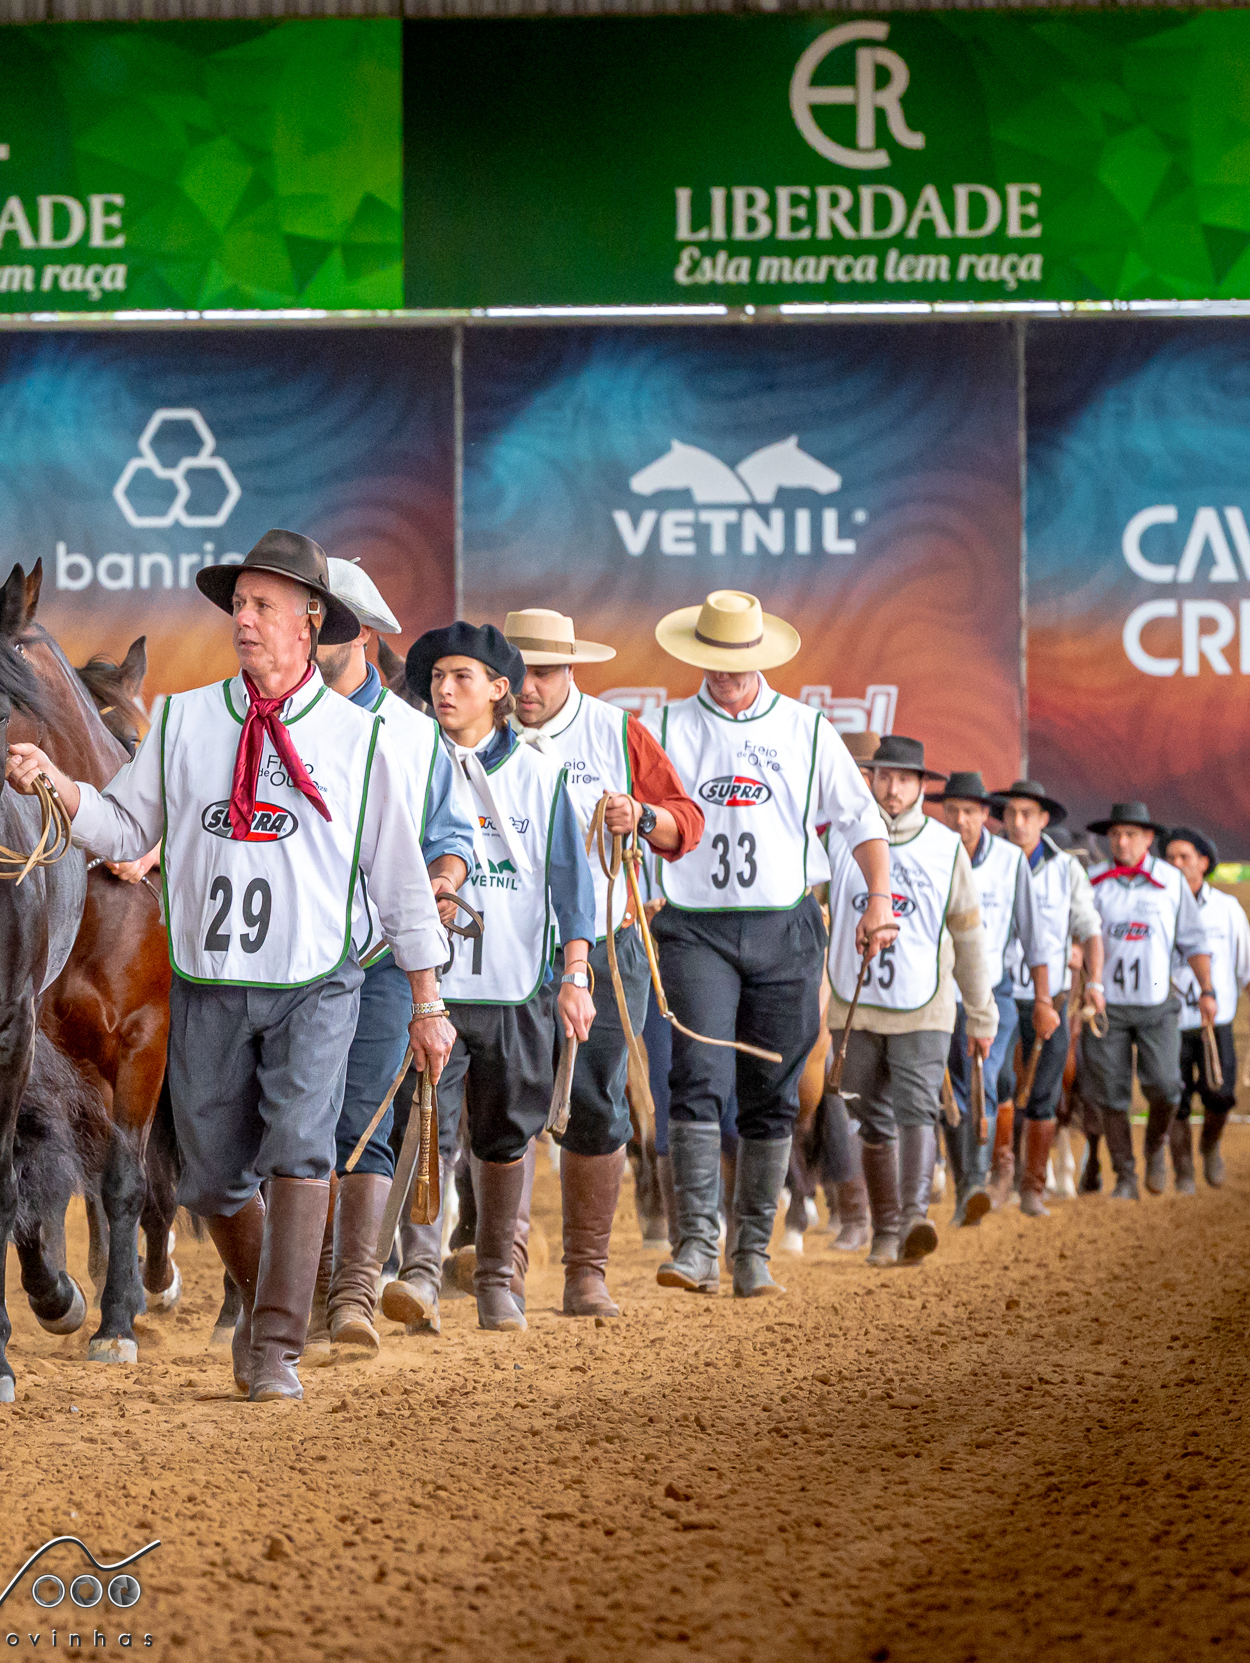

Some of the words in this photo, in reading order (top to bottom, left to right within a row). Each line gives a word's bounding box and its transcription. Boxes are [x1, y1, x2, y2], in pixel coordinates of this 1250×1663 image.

[675, 182, 1043, 241] LIBERDADE
[40, 263, 128, 301] raça
[675, 245, 751, 286] Esta
[756, 254, 878, 284] marca
[884, 247, 950, 282] tem
[956, 253, 1043, 291] raça
[612, 507, 857, 556] VETNIL
[56, 540, 245, 591] banri
[744, 740, 778, 758] Freio
[707, 784, 763, 799] SUPRA
[470, 874, 518, 891] VETNIL
[711, 832, 757, 890] 33
[204, 875, 272, 954] 29
[1113, 958, 1140, 992] 41
